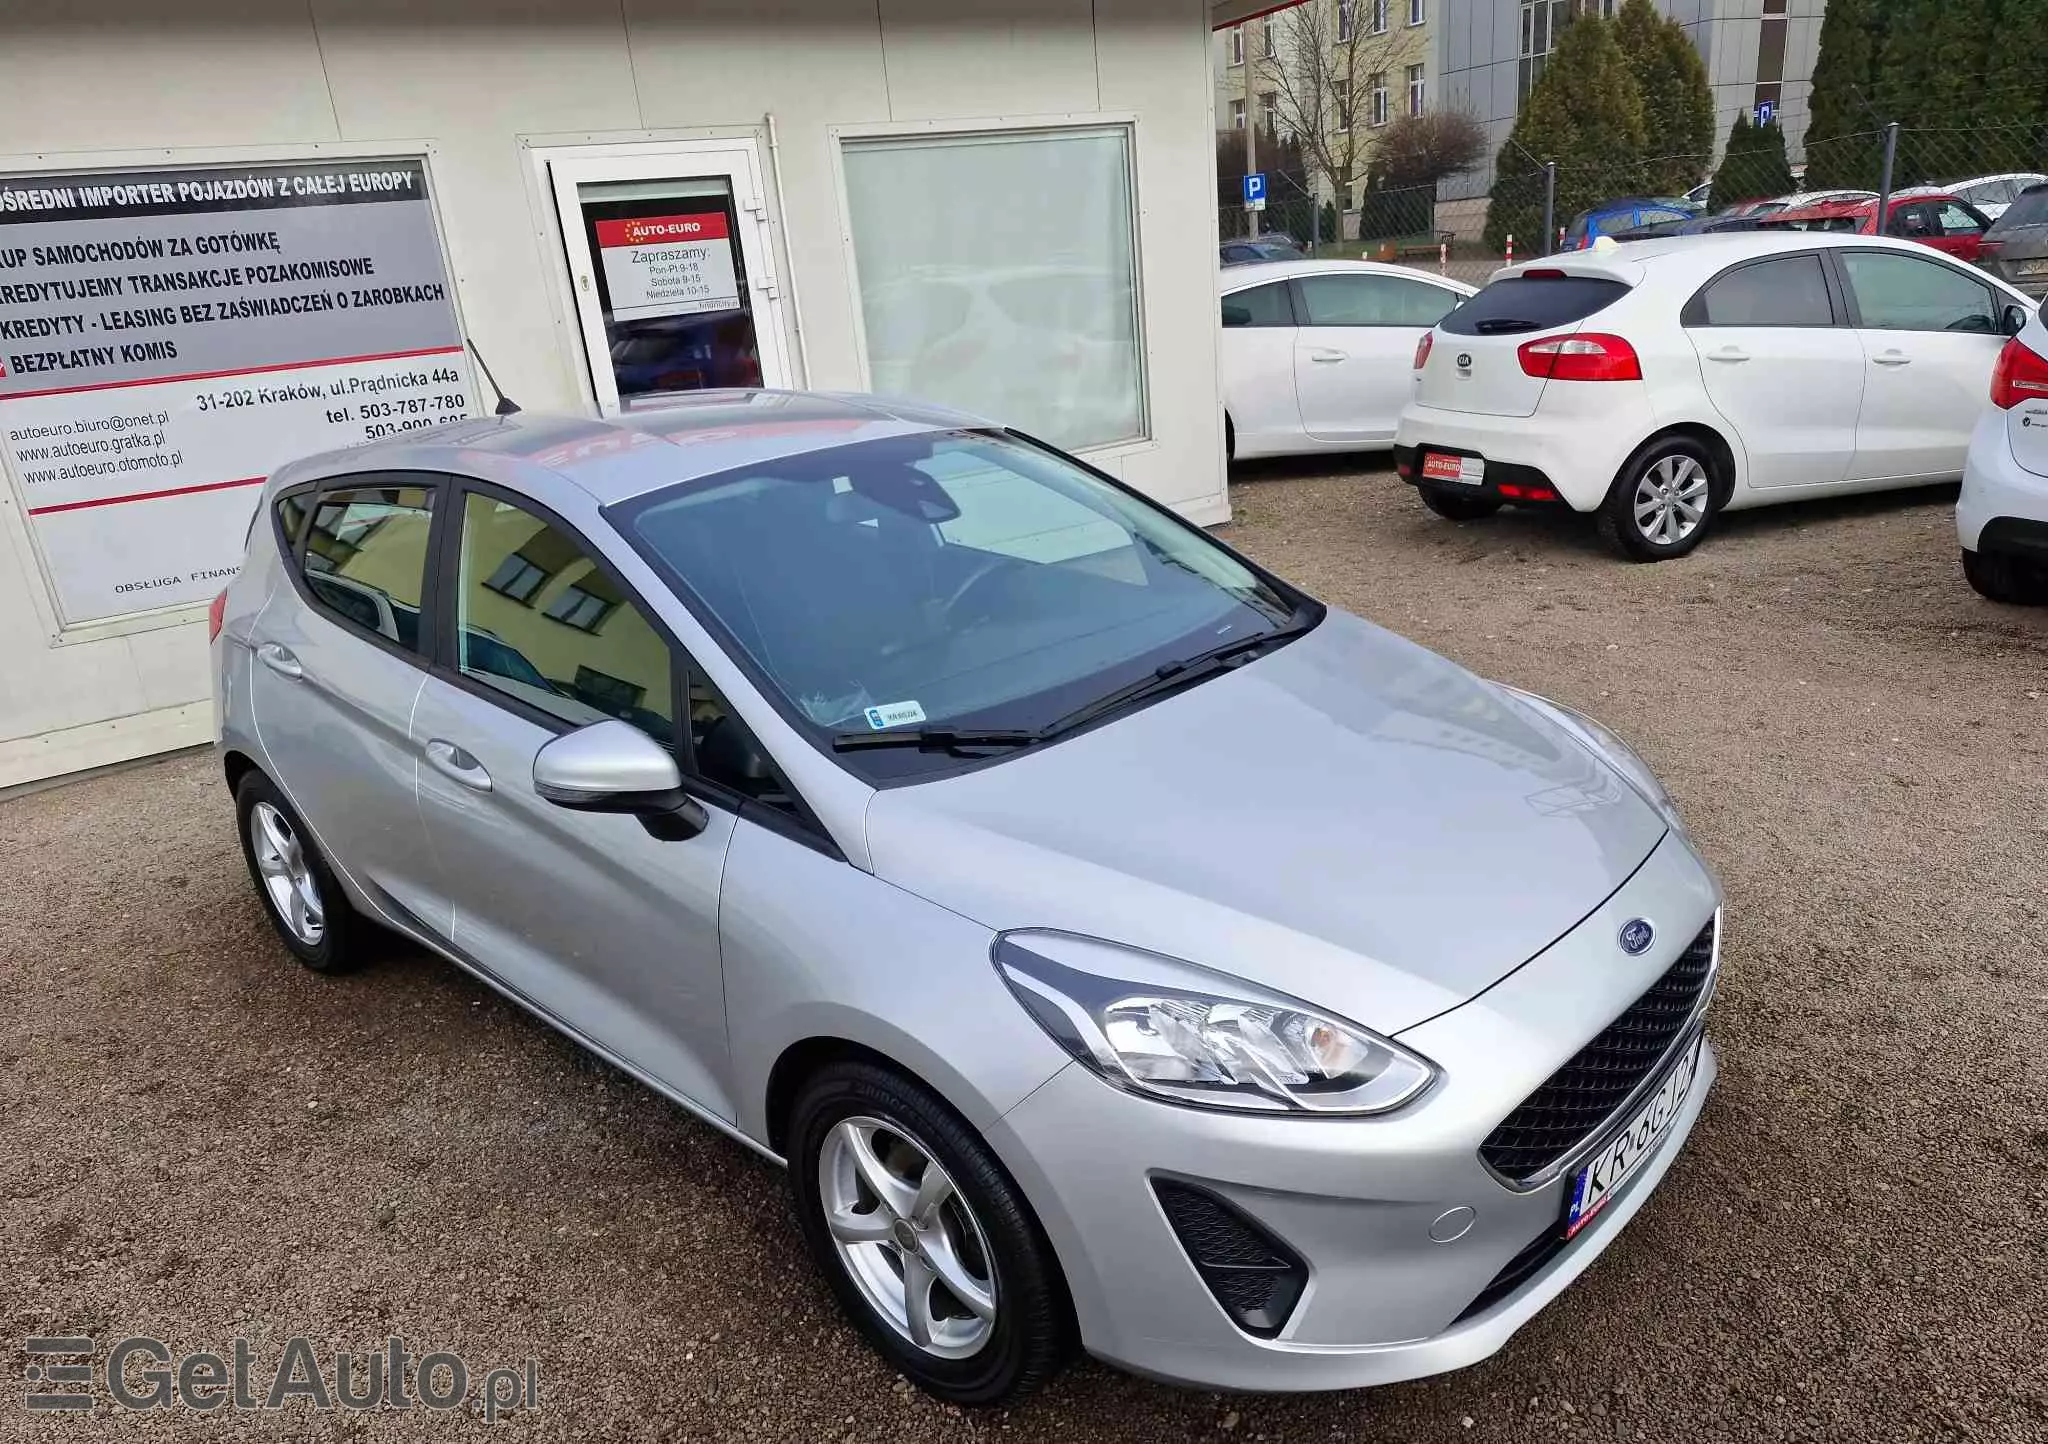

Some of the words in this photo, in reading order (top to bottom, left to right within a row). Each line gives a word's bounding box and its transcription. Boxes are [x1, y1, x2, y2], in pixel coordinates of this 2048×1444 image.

[79, 182, 175, 207] IMPORTER
[178, 174, 275, 203] POJAZDÓW
[279, 176, 291, 196] Z
[293, 174, 348, 195] CAŁEJ
[349, 171, 414, 192] EUROPY
[1248, 177, 1261, 197] P
[632, 222, 701, 237] AUTO-EURO
[0, 248, 27, 268] UP
[33, 236, 164, 267] SAMOCHODÓW
[168, 238, 194, 257] ZA
[195, 231, 282, 255] GOTÓWKĘ
[631, 247, 711, 265] Zapraszamy:
[128, 268, 244, 295] TRANSAKCJE
[246, 257, 375, 284] POZAKOMISOWE
[651, 277, 680, 287] Sobota
[647, 288, 684, 299] Niedziela
[687, 285, 710, 296] 10-15
[0, 315, 85, 340] KREDYTY
[100, 302, 177, 331] LEASING
[182, 302, 215, 324] BEZ
[217, 290, 334, 320] ZAŚWIADCZEŃ
[337, 290, 348, 309] O
[352, 284, 446, 307] ZAROBKACH
[10, 346, 115, 374] BEZPŁATNY
[121, 340, 178, 363] KOMIS
[196, 390, 255, 411] 31-202
[258, 383, 326, 405] Kraków,
[331, 371, 428, 396] ul.Prądnicka
[433, 367, 459, 384] 44a
[327, 407, 355, 424] tel.
[360, 394, 465, 419] 503-787-780
[10, 411, 170, 441] autoeuro.biuro@onet.pl
[16, 430, 166, 462] www.autoeuro.gratka.pl
[24, 450, 183, 484] www.autoeuro.otomoto.pl
[115, 576, 182, 594] OBSŁUGA
